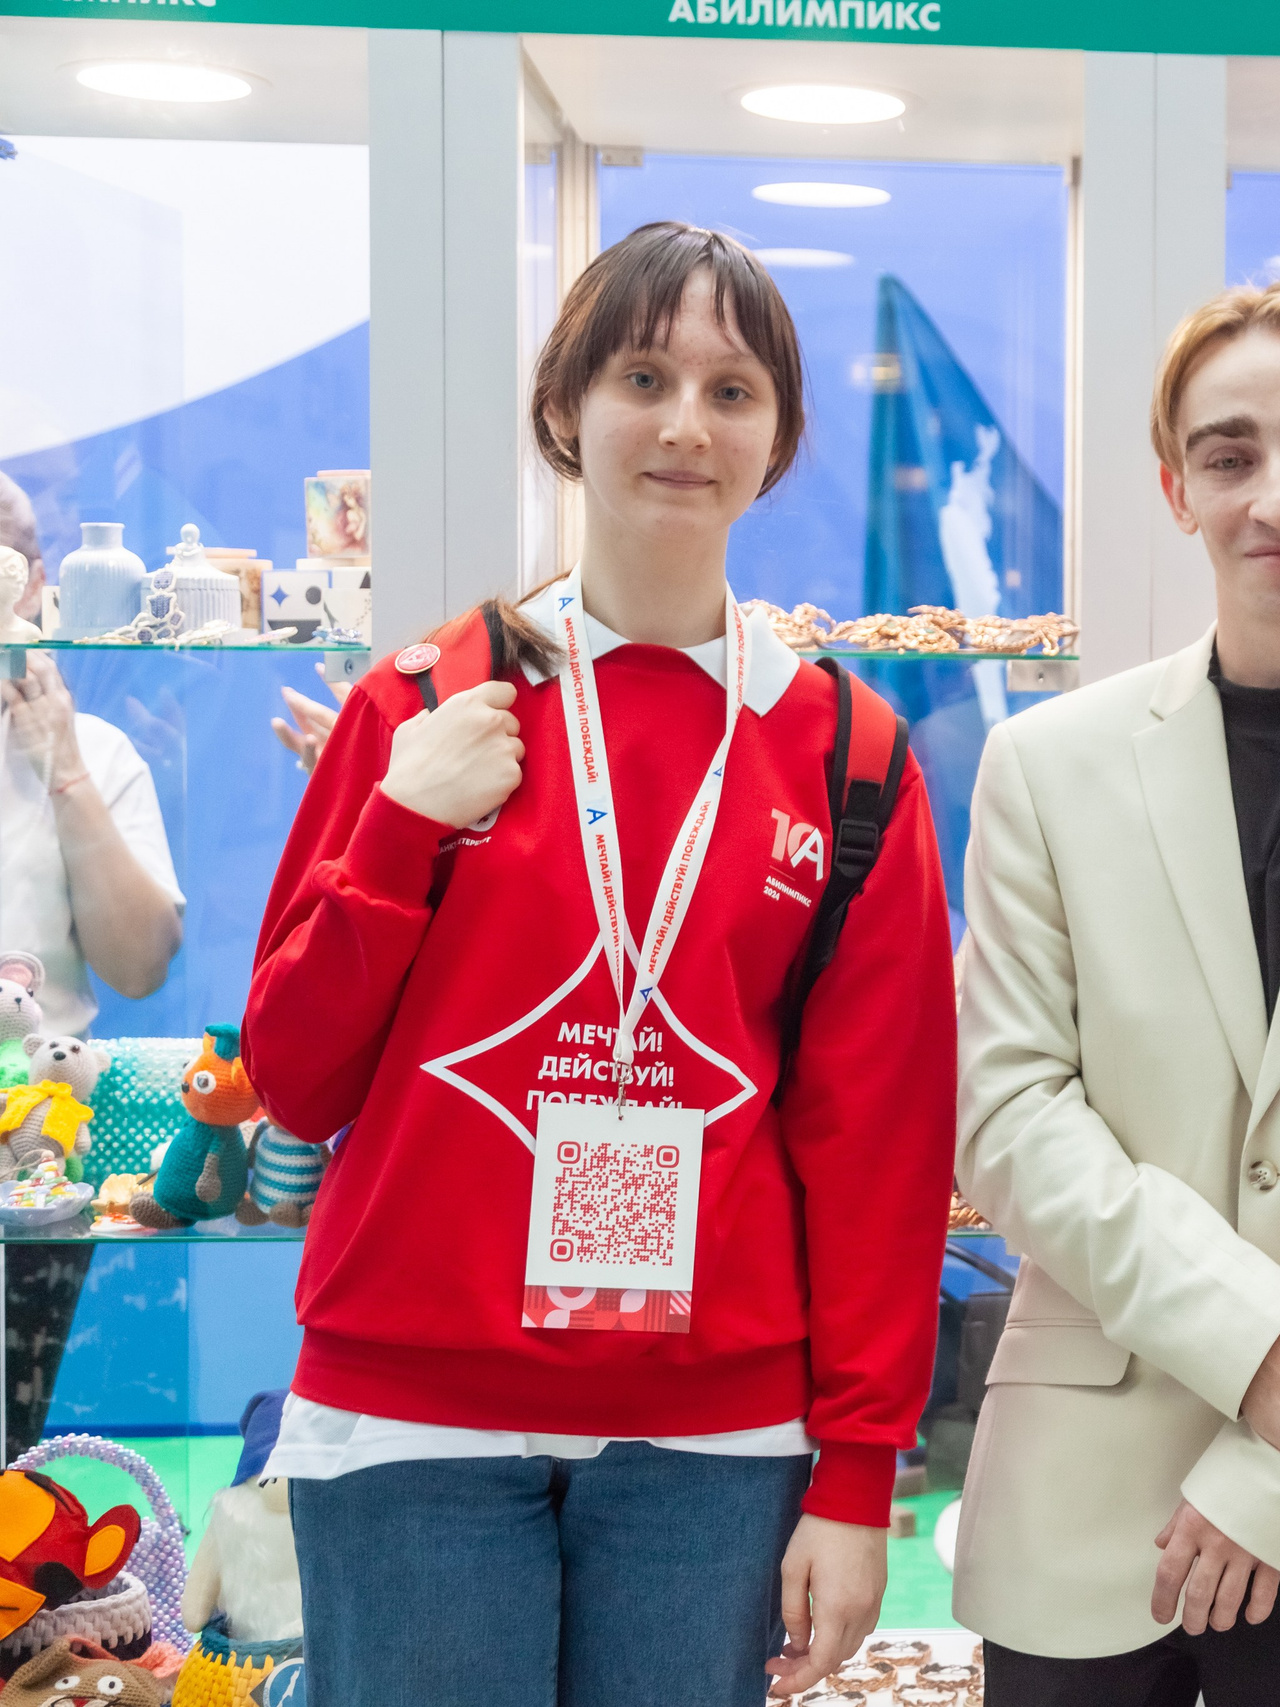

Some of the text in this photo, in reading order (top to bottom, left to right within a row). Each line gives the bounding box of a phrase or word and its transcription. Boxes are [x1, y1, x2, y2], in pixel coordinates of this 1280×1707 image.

[668, 0, 941, 32] АБИЛИМПИКС
[564, 617, 599, 784] МЕЧТАЙ! ДЕЙСТВУЙ! ПОБЕЖДАЙ!
[595, 834, 621, 948] МЕЧТАЙ! ДЕЙСТВУЙ!
[648, 800, 712, 975] МЕЧТАЙ! ДЕЙСТВУЙ! ПОБЕЖДАЙ!
[763, 886, 781, 901] 2024
[765, 875, 812, 908] АБИЛИМПИКС
[557, 1022, 663, 1052] МЕЧЙ!
